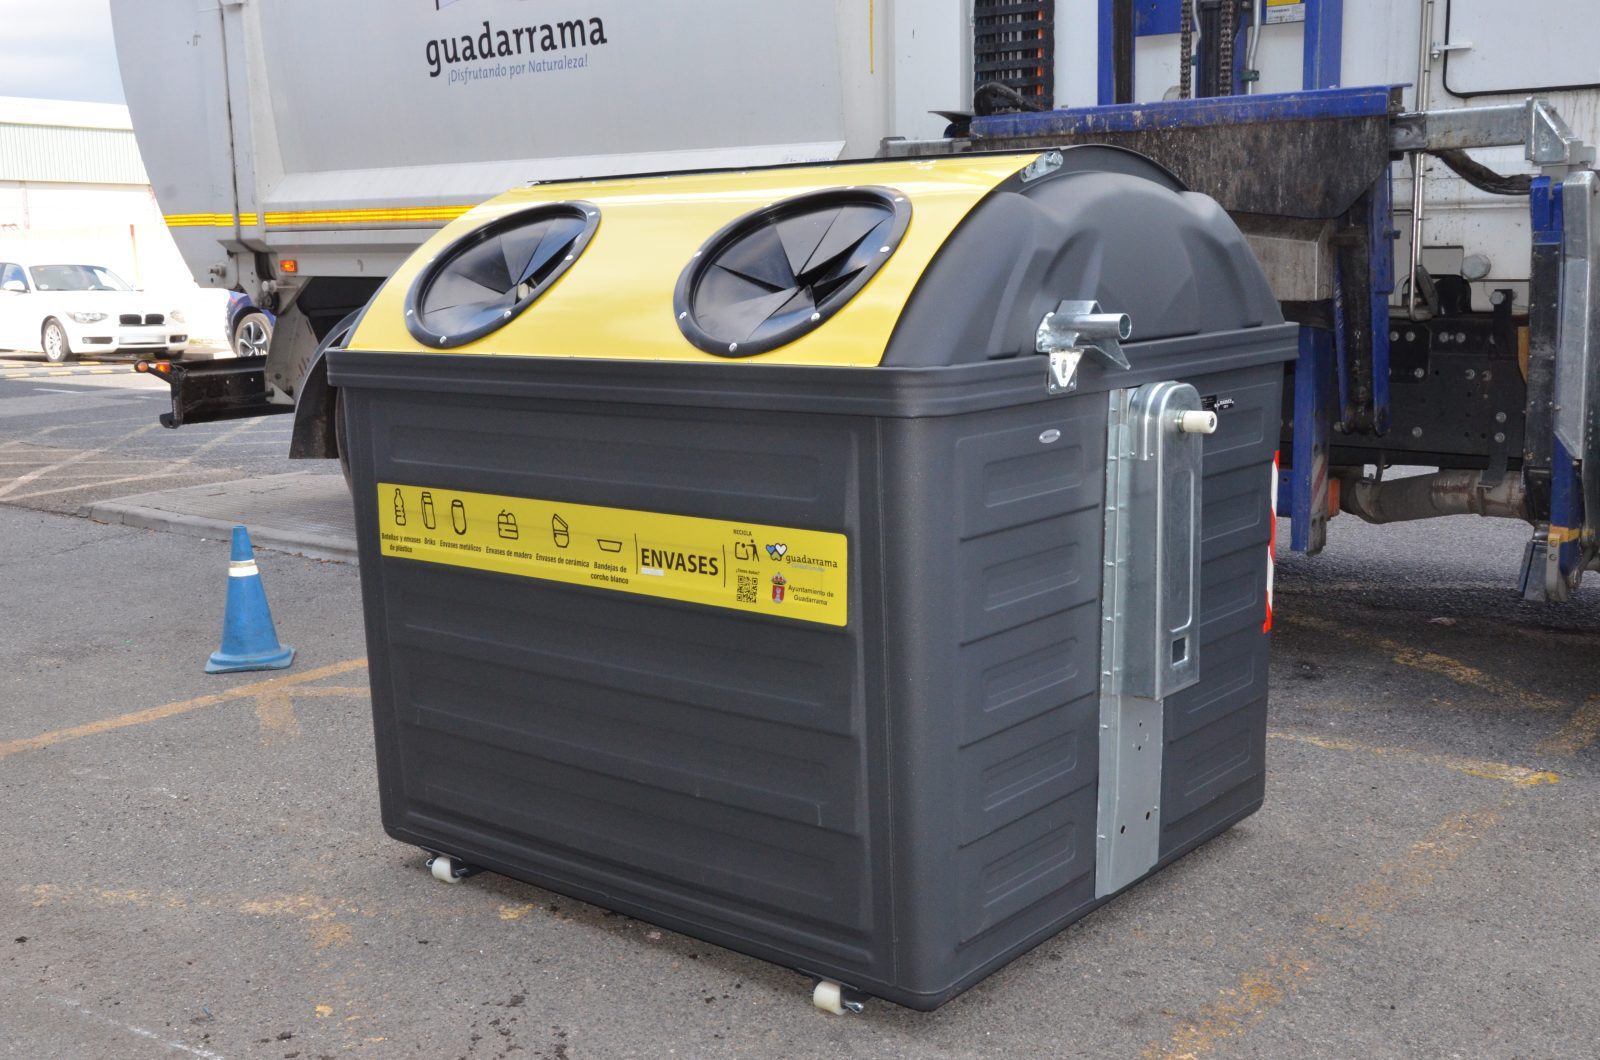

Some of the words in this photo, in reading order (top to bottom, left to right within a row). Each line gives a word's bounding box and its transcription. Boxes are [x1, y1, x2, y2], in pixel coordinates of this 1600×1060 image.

[426, 16, 608, 77] guadarrama
[448, 63, 506, 86] ¡Disfrutando
[510, 63, 526, 80] por
[528, 54, 588, 74] Naturaleza!
[440, 540, 458, 549] Envases
[459, 542, 482, 552] metálicos
[486, 546, 506, 556] Envases
[514, 551, 532, 559] madera
[536, 553, 556, 564] Envases
[558, 556, 564, 564] de
[565, 558, 590, 568] cerámica
[641, 548, 719, 576] ENVASES
[786, 554, 838, 568] guadarrama
[594, 562, 618, 573] Bandejas
[591, 572, 609, 582] corcho
[610, 575, 629, 584] blanco
[788, 584, 825, 596] Ayuntamiento
[794, 594, 828, 606] Guadarrama
